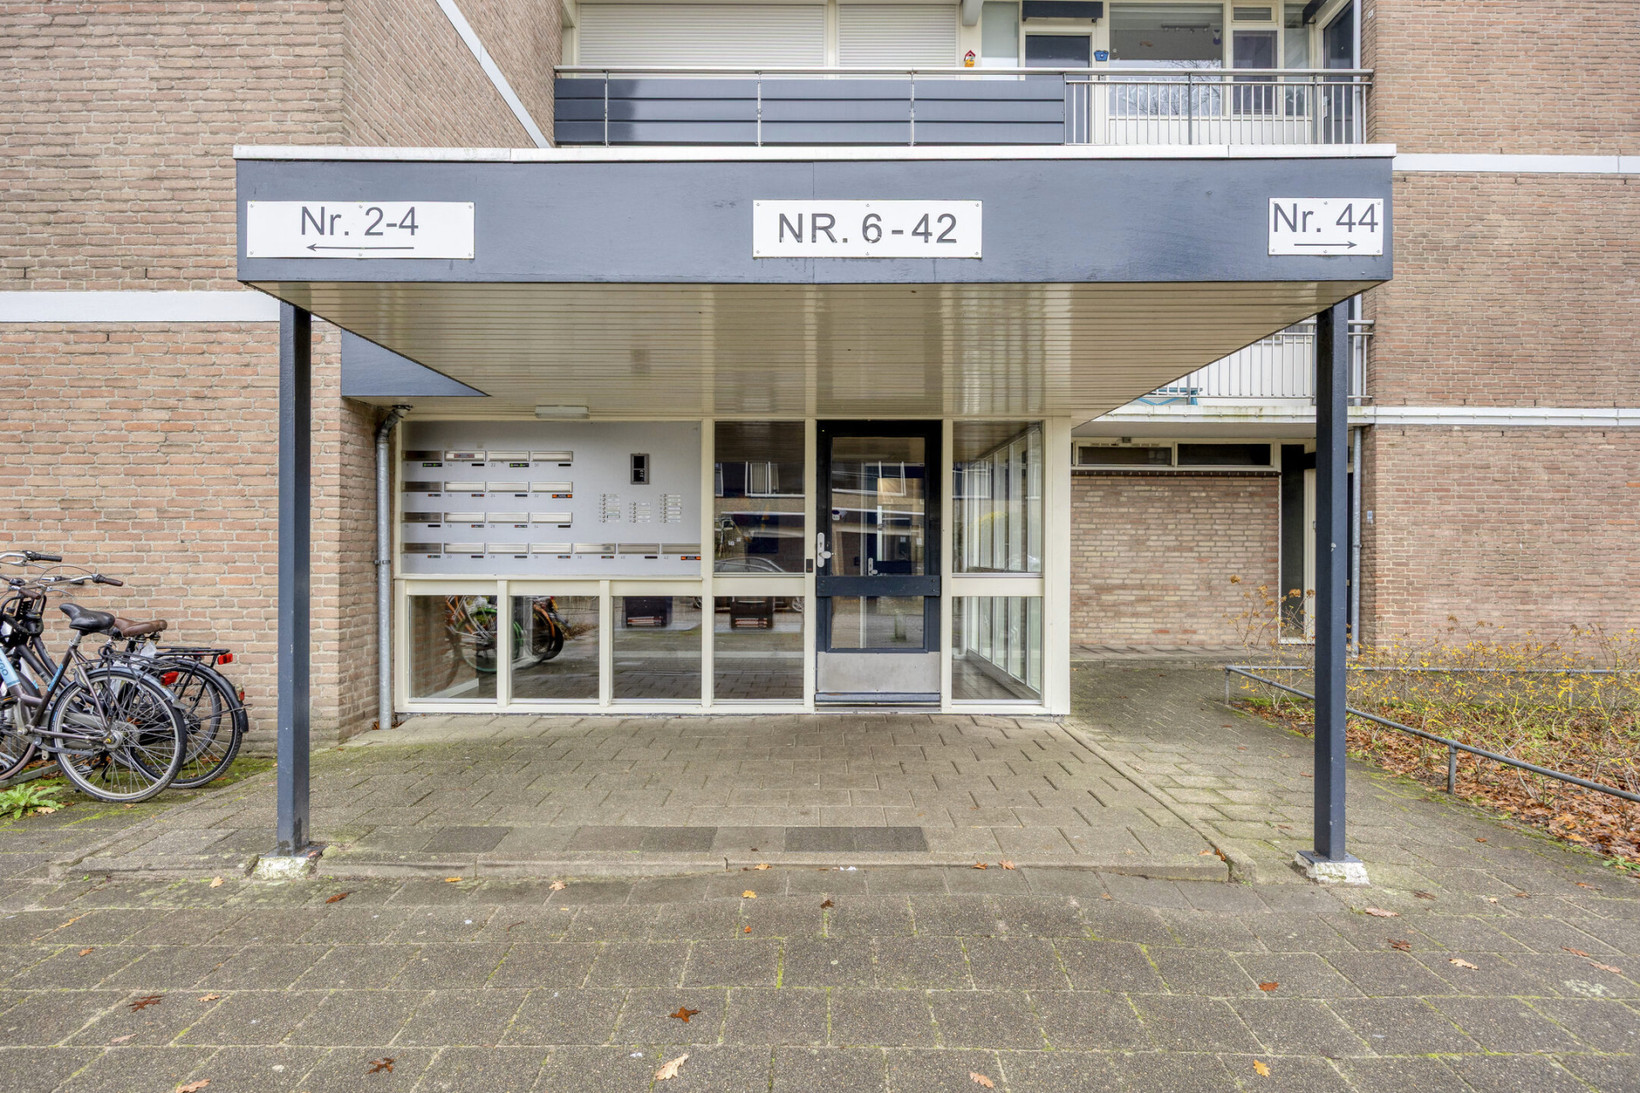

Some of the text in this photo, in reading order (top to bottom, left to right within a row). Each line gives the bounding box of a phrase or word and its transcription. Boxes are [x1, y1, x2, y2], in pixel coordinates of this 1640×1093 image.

[301, 206, 419, 236] Nr. 2-4
[779, 213, 957, 244] NR. 6-42
[1273, 203, 1379, 233] Nr. 44
